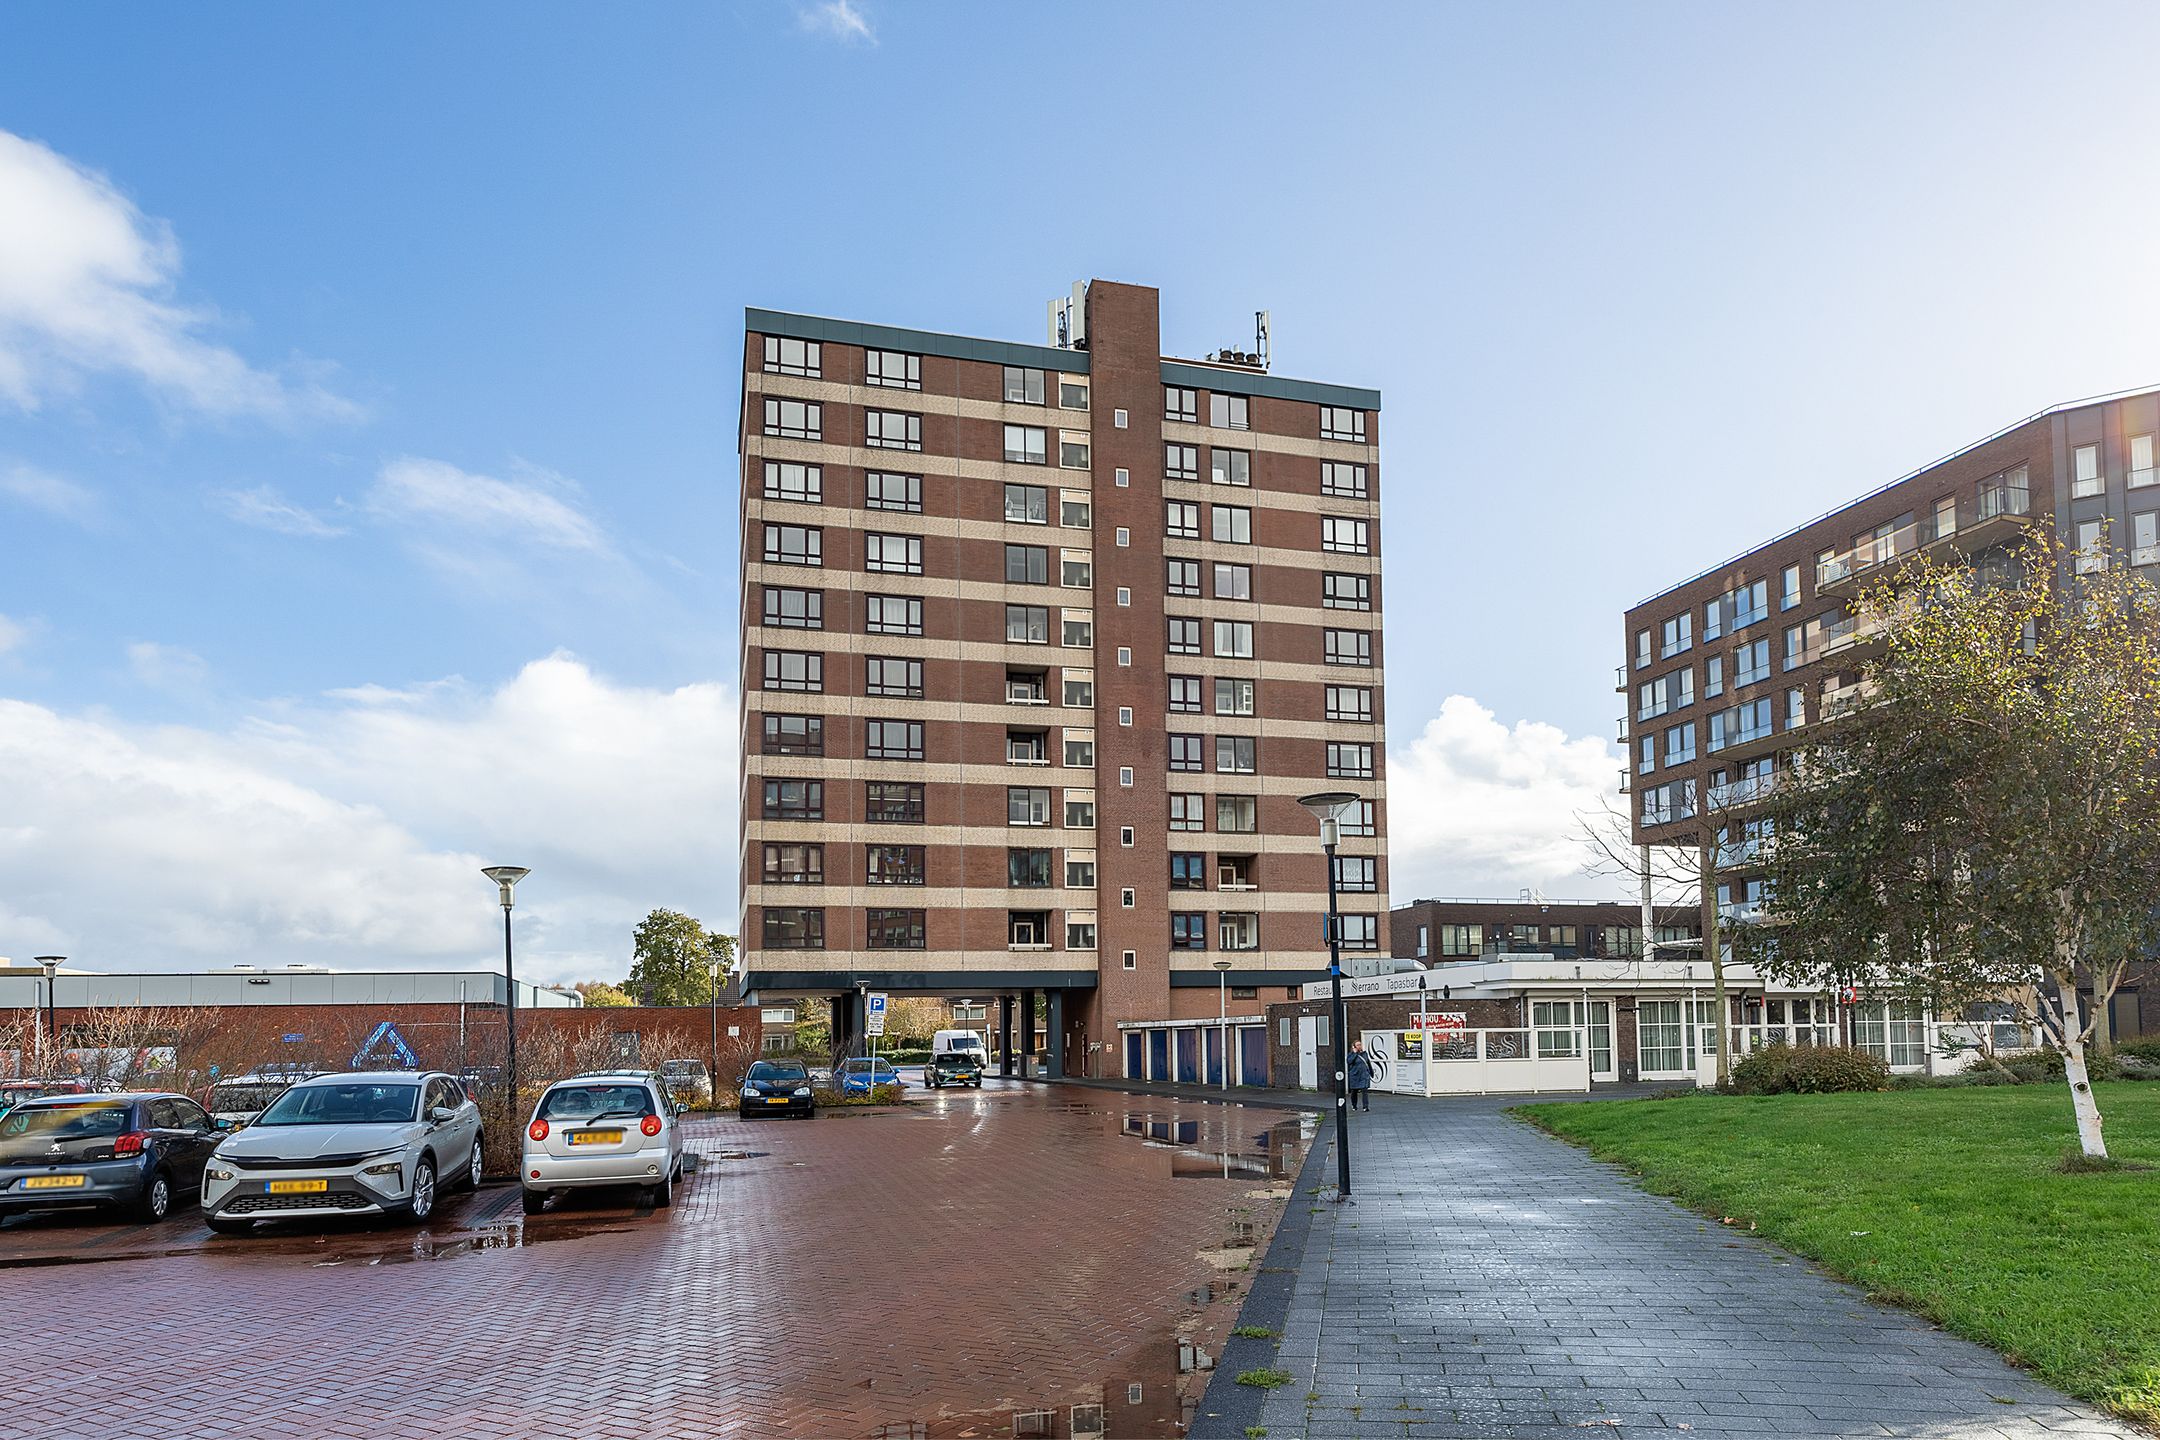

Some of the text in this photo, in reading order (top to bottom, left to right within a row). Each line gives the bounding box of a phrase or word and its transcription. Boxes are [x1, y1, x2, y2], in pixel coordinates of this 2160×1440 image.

[1313, 977, 1419, 996] Restaut Serrano Tapasbar
[873, 999, 882, 1010] P
